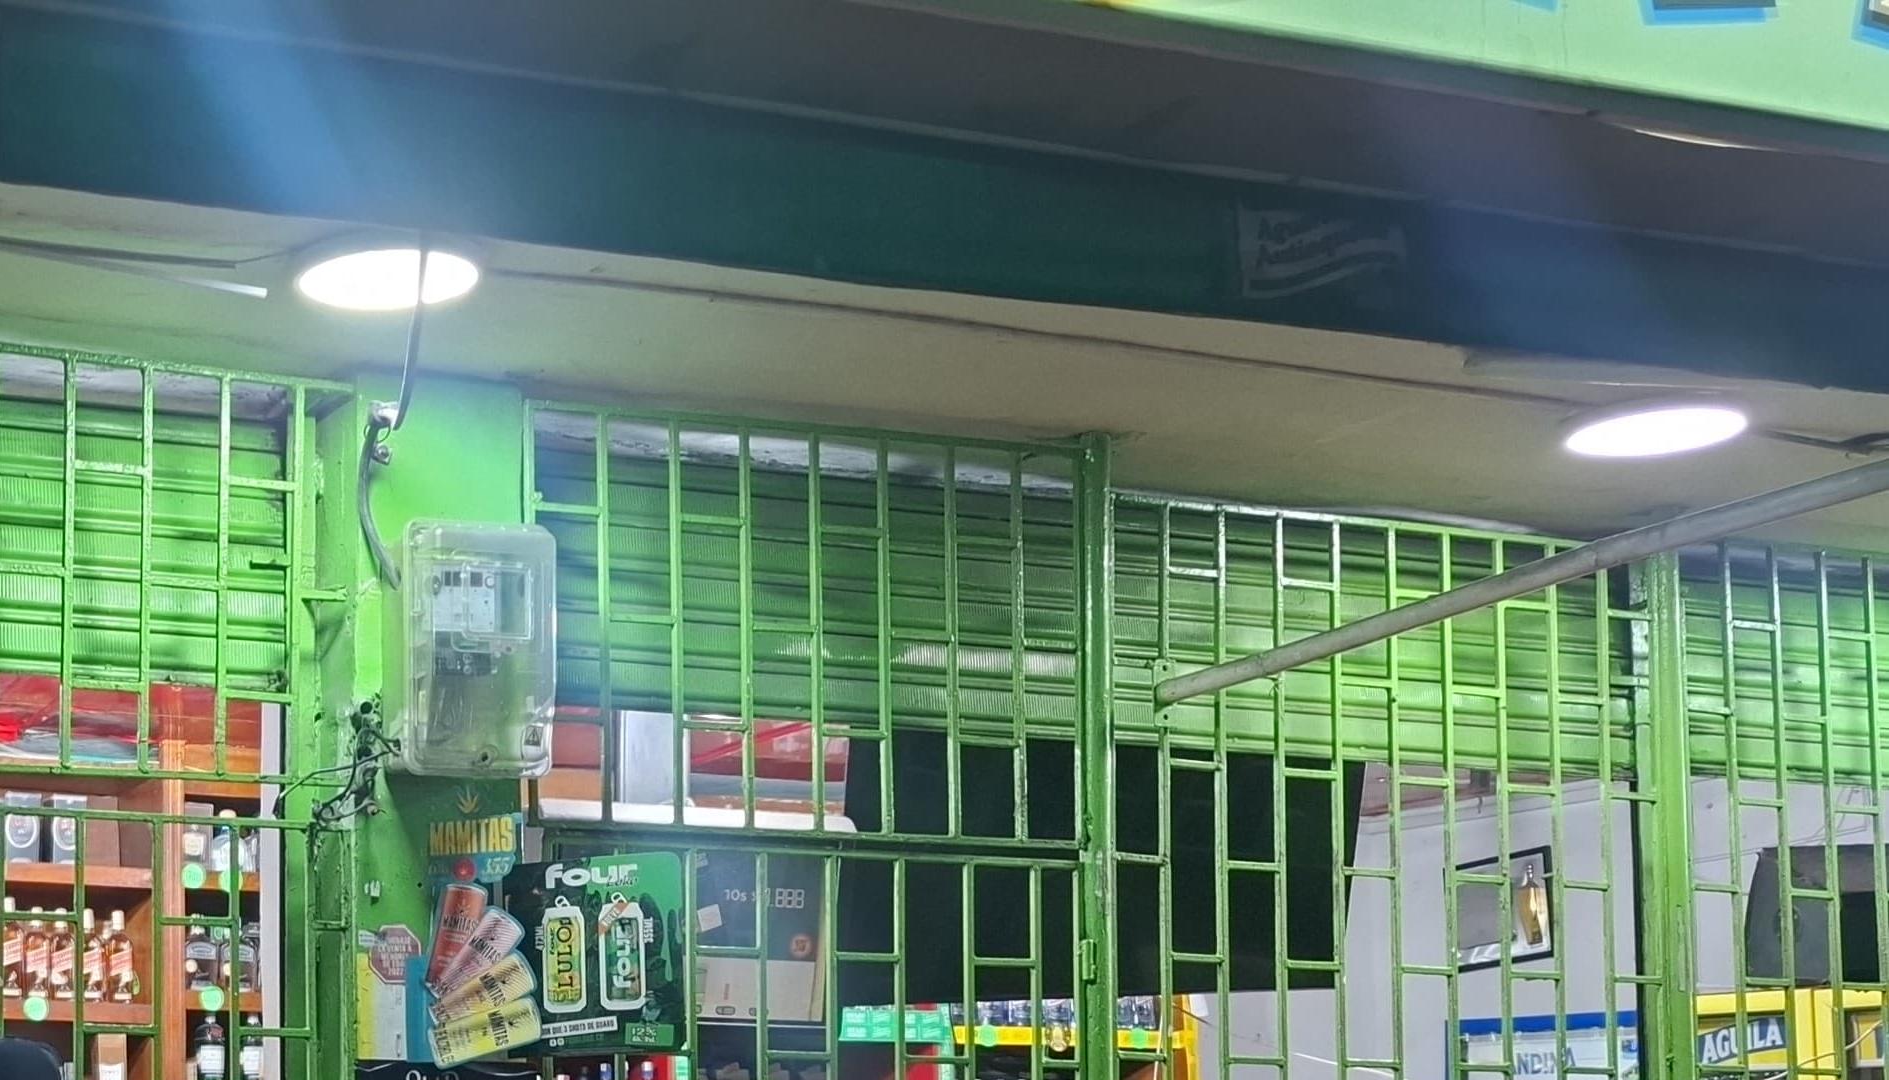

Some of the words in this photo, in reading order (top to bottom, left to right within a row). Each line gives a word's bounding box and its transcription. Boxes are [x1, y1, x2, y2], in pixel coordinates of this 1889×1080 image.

[430, 817, 514, 854] MAMITAS
[545, 863, 638, 889] four
[487, 1010, 510, 1047] MAMITAS
